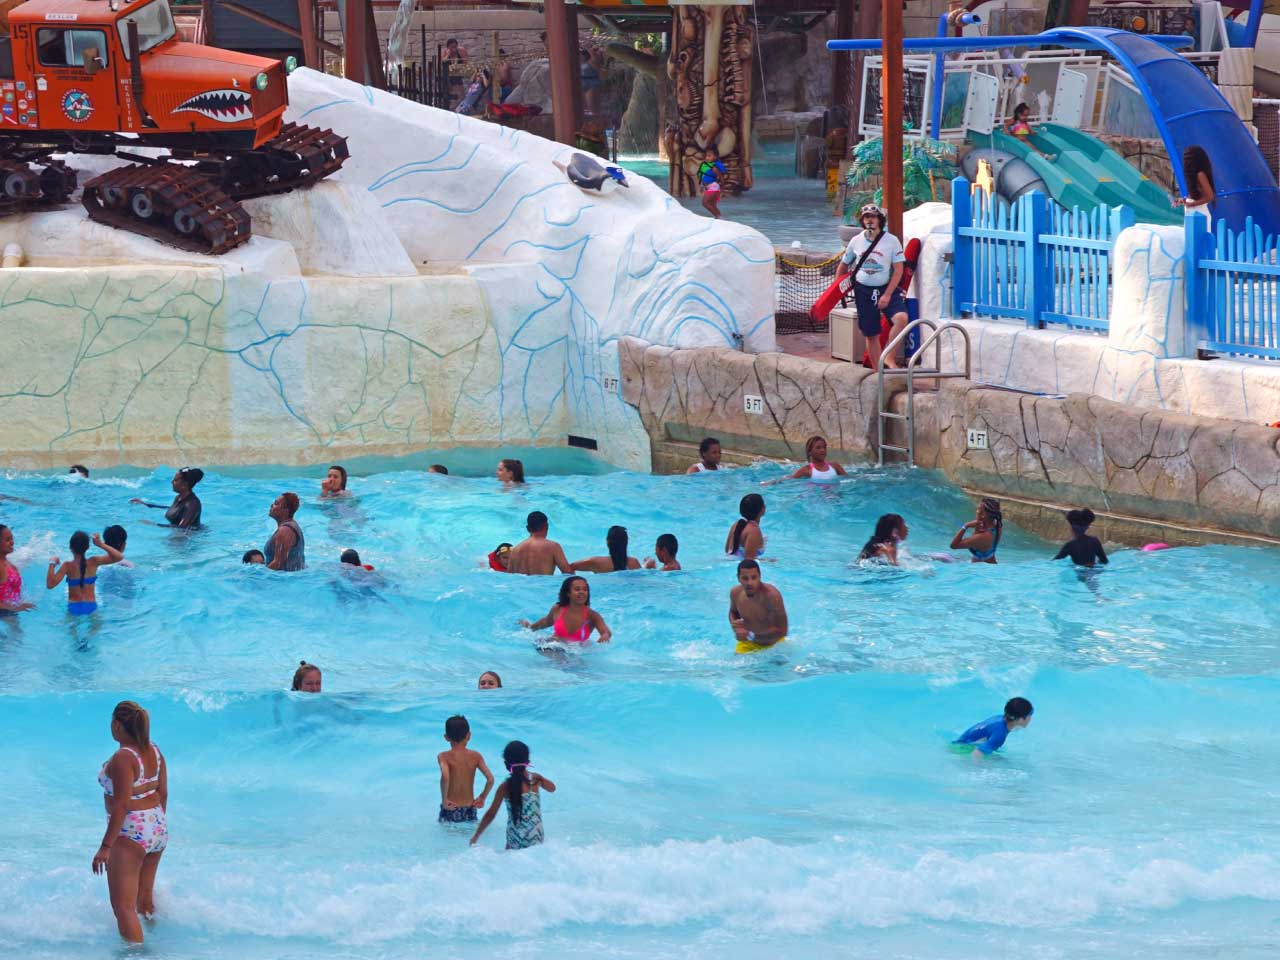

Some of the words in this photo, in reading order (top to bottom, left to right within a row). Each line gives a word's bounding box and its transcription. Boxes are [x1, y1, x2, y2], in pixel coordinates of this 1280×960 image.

[13, 24, 28, 39] 15
[746, 398, 751, 410] 5
[753, 399, 761, 411] FT
[970, 432, 975, 444] 4
[977, 433, 985, 446] FT
